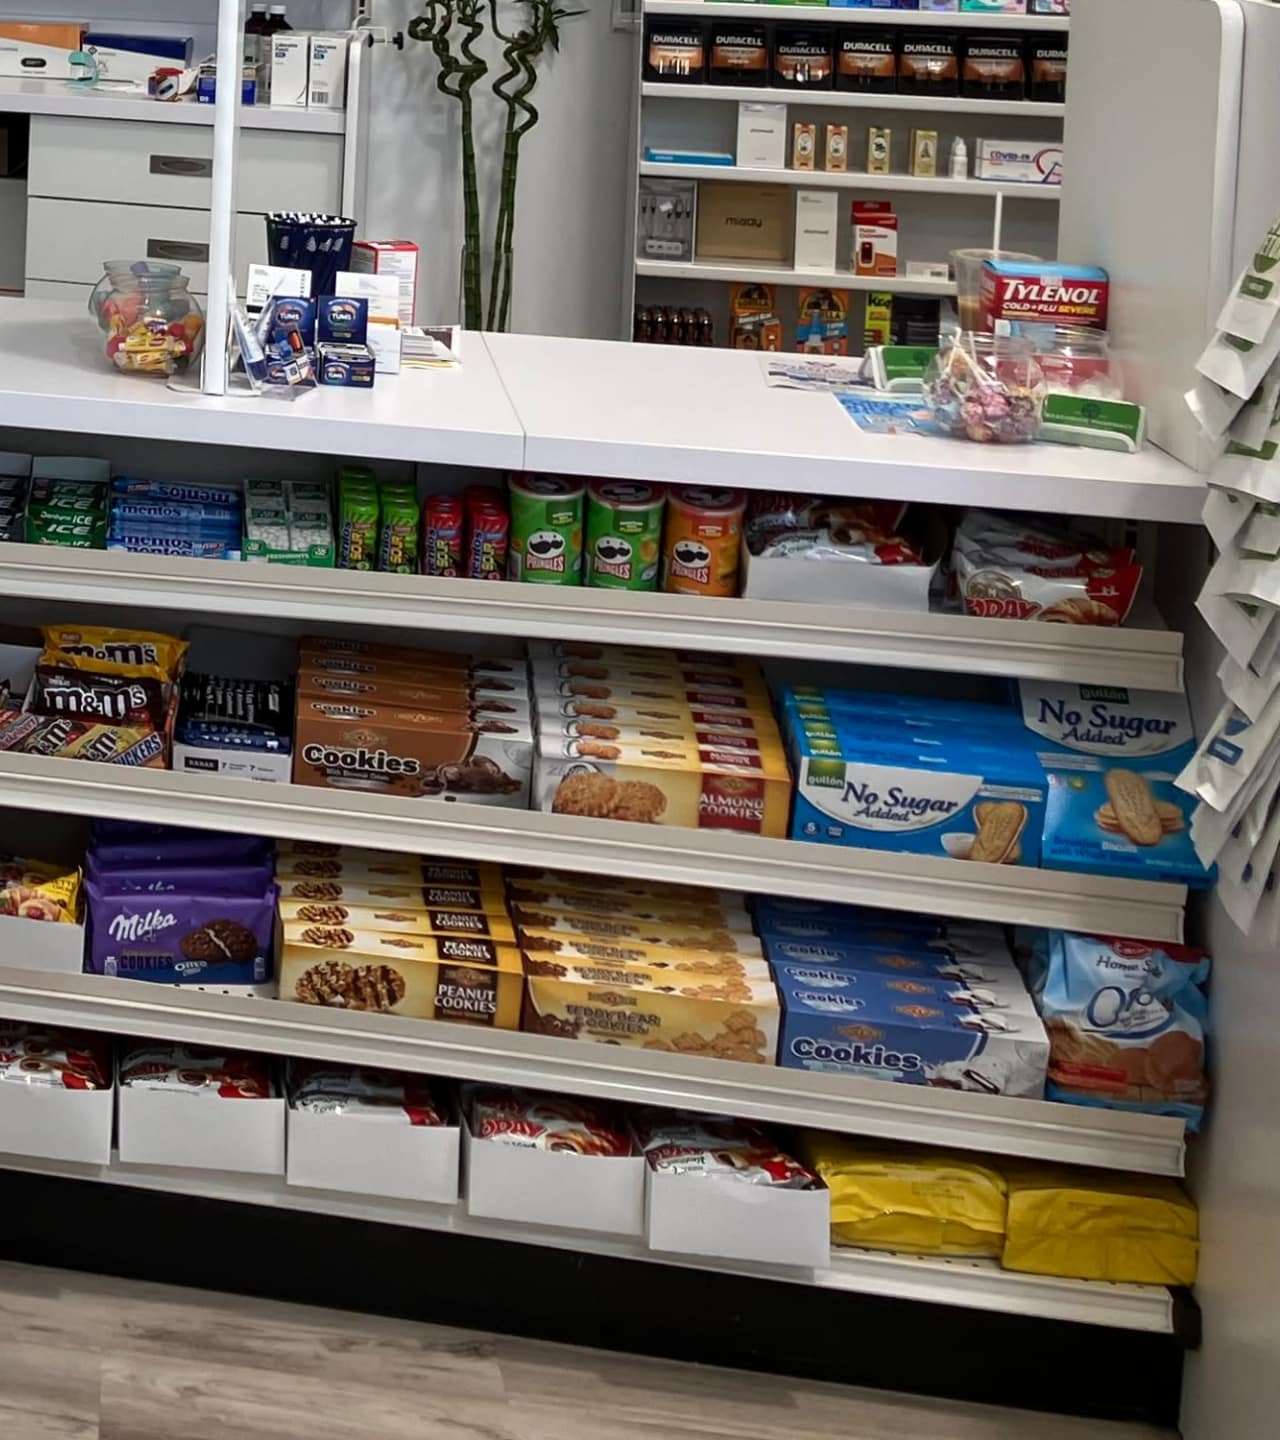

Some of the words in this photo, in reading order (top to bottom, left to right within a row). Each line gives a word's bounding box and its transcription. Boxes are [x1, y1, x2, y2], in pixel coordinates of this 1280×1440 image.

[652, 34, 699, 45] DURACELL
[715, 35, 763, 46] DURACELL
[843, 41, 892, 52] DURACELL
[903, 43, 953, 54] DURACELL
[778, 44, 827, 55] DURACELL
[968, 46, 1019, 58] DURACELL
[1002, 280, 1101, 303] TYLENOL
[158, 486, 231, 504] mentos
[72, 514, 93, 525] ICE
[122, 505, 182, 518] mentos
[47, 523, 91, 535] ICE
[351, 531, 363, 560] SOUR
[390, 535, 404, 564] SOUR
[436, 539, 449, 568] SOUR
[482, 543, 496, 571] SOUR
[526, 554, 564, 572] PRINGLES
[594, 560, 632, 580] PRINGLES
[671, 565, 709, 583] PRINGLES
[43, 685, 148, 718] m&m's
[1038, 697, 1082, 726] No
[1088, 704, 1177, 738] Sugar
[1062, 726, 1127, 745] Added
[302, 743, 421, 775] Cookies
[699, 794, 764, 810] ALMOND
[841, 779, 880, 806] No
[882, 786, 958, 815] Sugar
[698, 804, 763, 820] COOKIES
[853, 806, 910, 822] Added
[108, 909, 178, 942] Milka
[442, 947, 491, 960] COOKIES
[444, 939, 488, 952] PEANUT
[783, 965, 857, 984] Cookies
[436, 984, 496, 1002] PEANUT
[792, 990, 866, 1009] Cookies
[434, 997, 497, 1015] COOKIES
[565, 1004, 610, 1019] TEDDY
[611, 1008, 661, 1028] BEAR
[576, 1017, 650, 1036] COOKIES
[791, 1036, 921, 1072] Cookies
